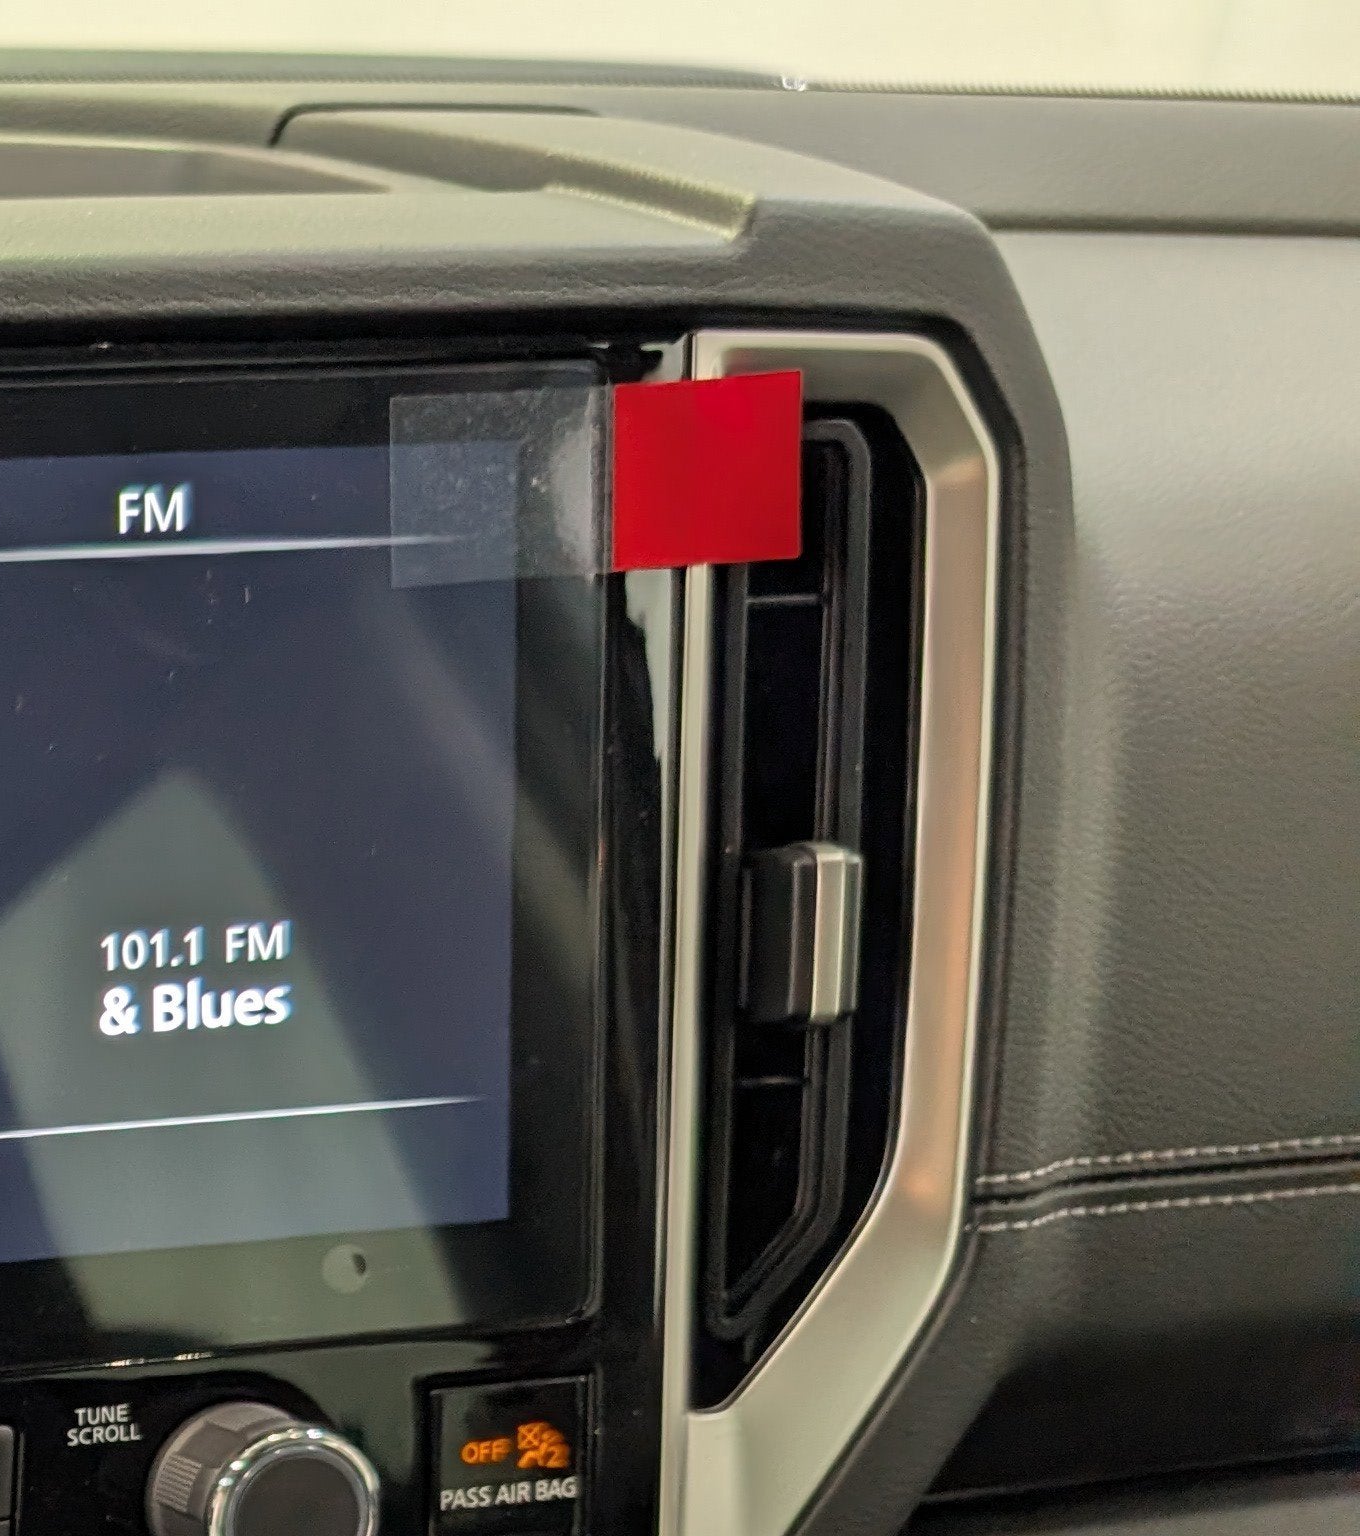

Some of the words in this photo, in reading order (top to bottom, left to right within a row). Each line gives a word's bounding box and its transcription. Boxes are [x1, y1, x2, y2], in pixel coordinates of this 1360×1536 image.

[117, 485, 189, 534] FM
[98, 925, 206, 971] 101.1
[224, 918, 292, 963] FM
[97, 984, 140, 1037] &
[151, 977, 292, 1030] Blues
[74, 1402, 130, 1425] TUNE
[66, 1421, 142, 1448] SCROLL
[460, 1436, 512, 1466] OFF
[439, 1486, 491, 1512] PASS
[494, 1480, 532, 1506] AIR
[534, 1474, 579, 1500] BAG
